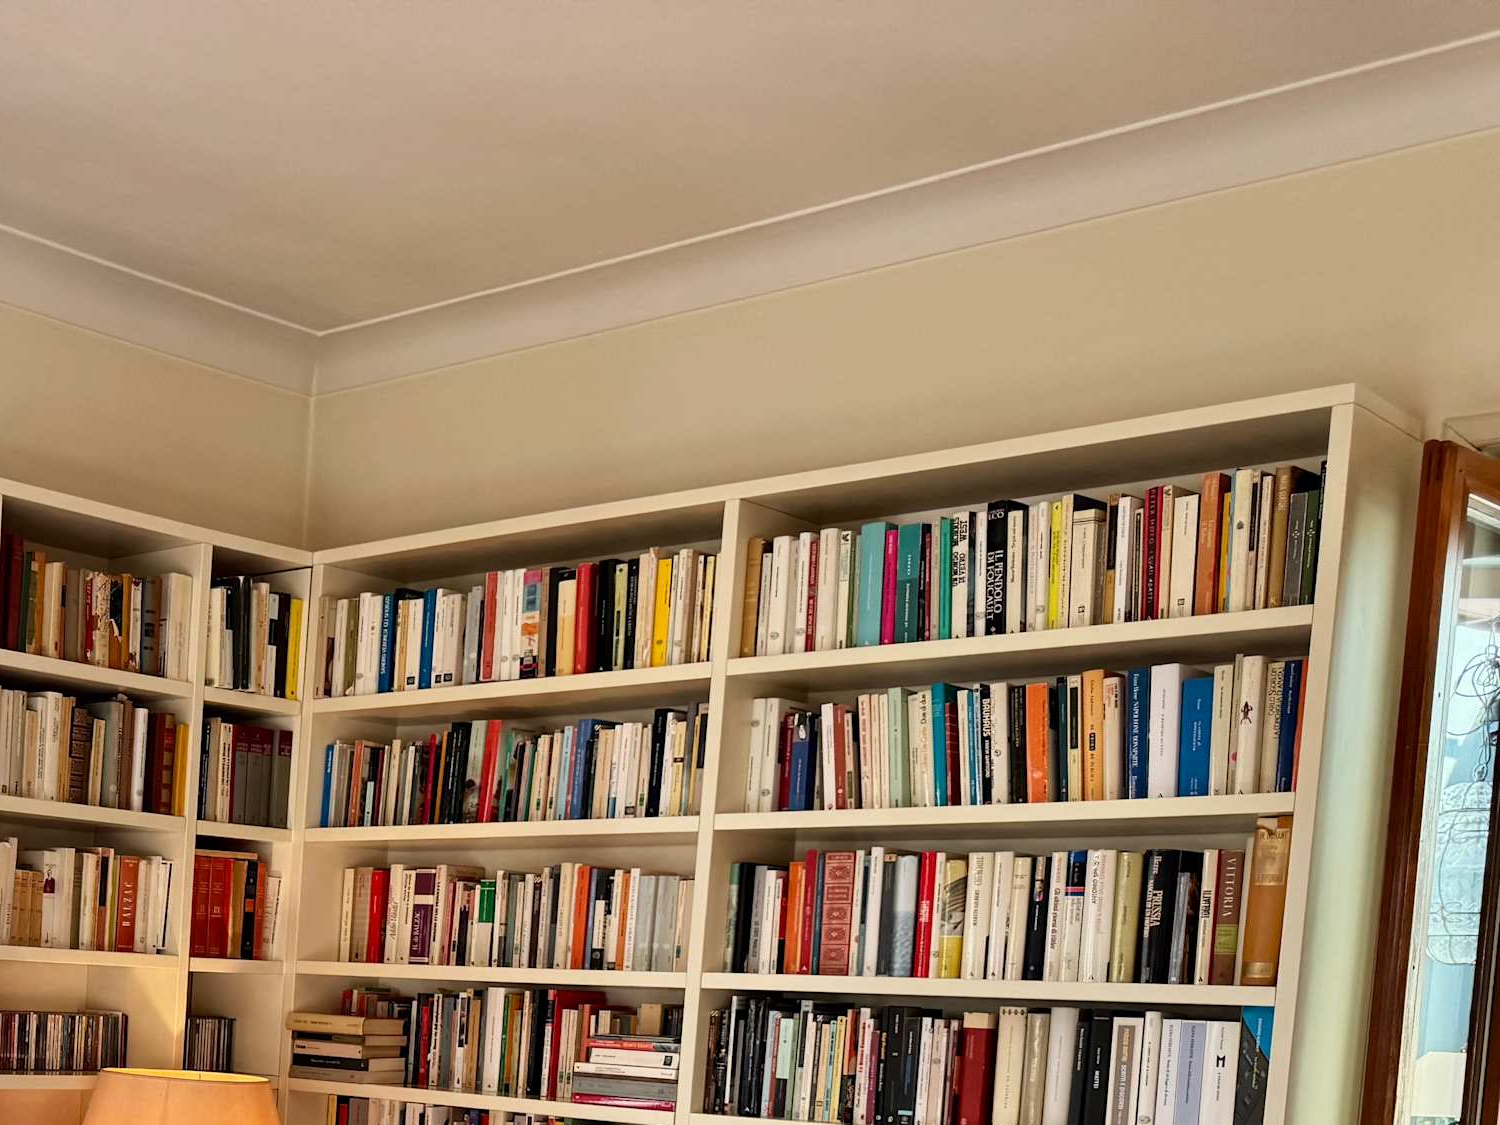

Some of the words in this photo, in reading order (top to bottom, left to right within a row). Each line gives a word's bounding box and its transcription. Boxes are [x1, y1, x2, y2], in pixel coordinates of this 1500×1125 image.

[959, 520, 967, 542] WEST
[987, 552, 993, 563] DI
[995, 550, 1004, 561] IL
[986, 566, 995, 620] FOUCAULT
[994, 562, 1004, 613] PENDOLO
[982, 698, 990, 737] BAUHAUS
[122, 882, 133, 927] BALZAC
[1222, 857, 1237, 917] VITTORIA
[1150, 889, 1163, 927] PRUSSIA
